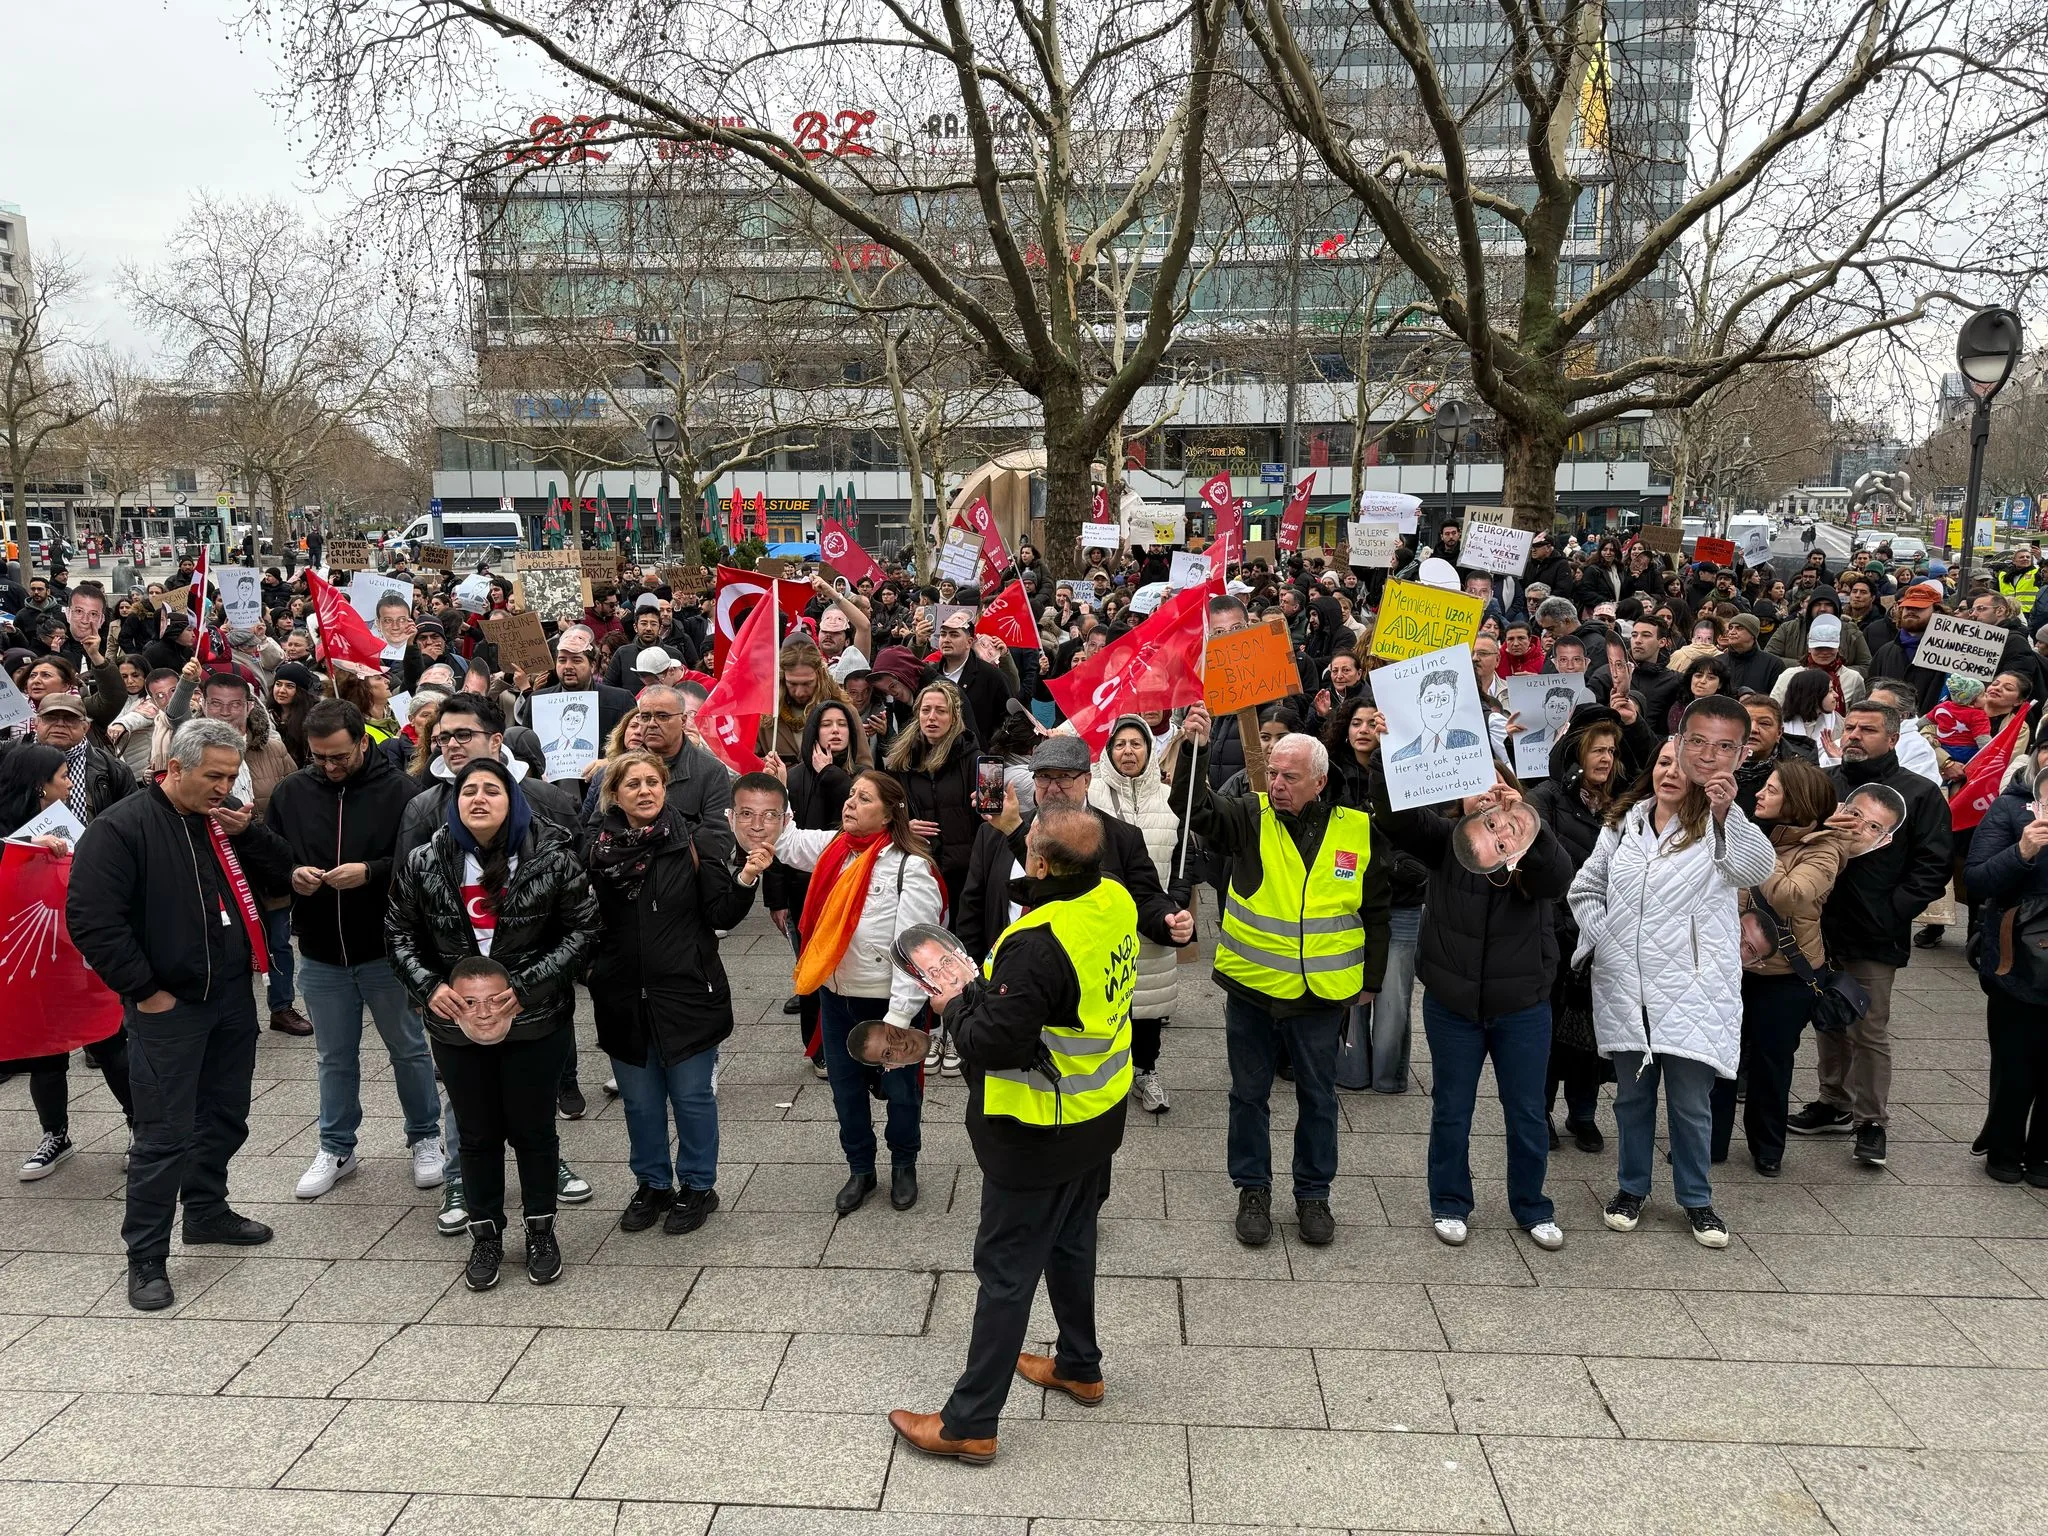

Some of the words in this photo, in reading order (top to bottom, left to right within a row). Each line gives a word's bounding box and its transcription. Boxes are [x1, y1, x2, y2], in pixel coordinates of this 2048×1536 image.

[561, 499, 597, 512] KFC
[1477, 524, 1524, 540] EUROPA!!!
[330, 541, 347, 550] STOP
[1358, 538, 1386, 547] DEUTSCH
[1470, 533, 1519, 552] Verteidige
[331, 550, 362, 558] CRIMES
[342, 557, 370, 565] TURKEY
[1490, 548, 1520, 561] WERTE
[667, 568, 681, 579] HAK
[682, 566, 701, 577] HUKU
[1388, 587, 1441, 618] Memleket
[1383, 614, 1469, 649] ADALET
[1952, 622, 1982, 640] NESİL
[1984, 629, 2006, 644] DAHA
[1375, 640, 1406, 657] daha
[1922, 651, 1951, 667] YOLU
[1987, 658, 1997, 666] DE
[1394, 655, 1449, 680] üzülme
[1395, 764, 1412, 775] Her
[1415, 761, 1429, 774] şey
[1433, 755, 1449, 768] çok
[1455, 748, 1483, 765] güzel
[1426, 767, 1459, 781] olacak
[1404, 776, 1483, 800] #alleswirdgut
[1335, 869, 1354, 879] CHP
